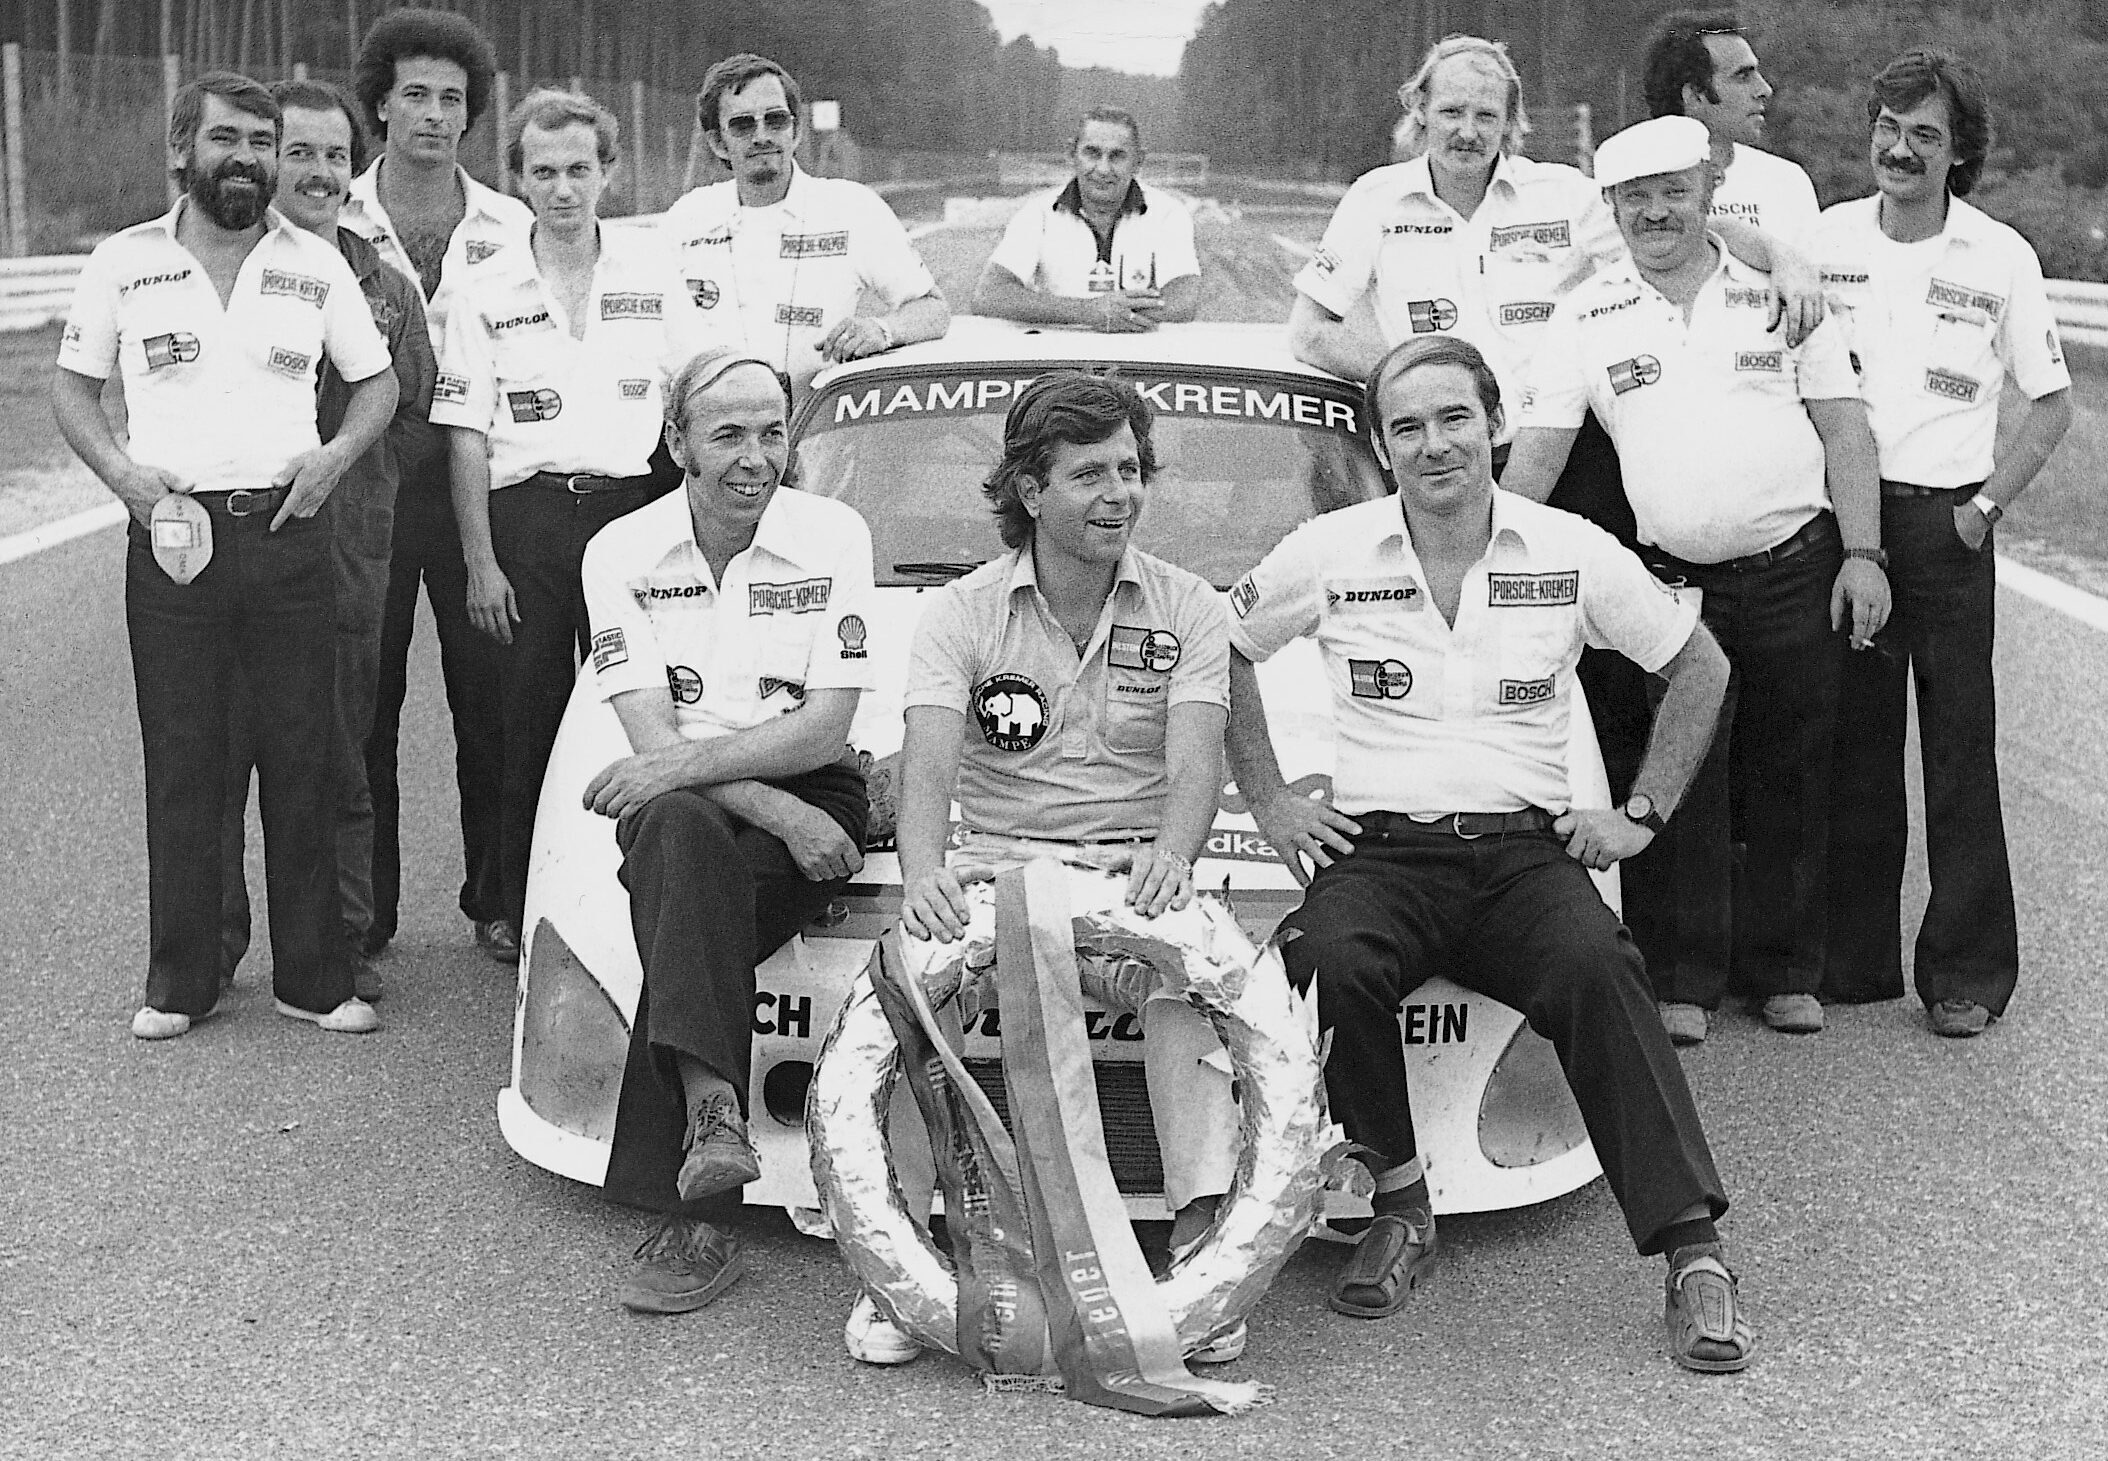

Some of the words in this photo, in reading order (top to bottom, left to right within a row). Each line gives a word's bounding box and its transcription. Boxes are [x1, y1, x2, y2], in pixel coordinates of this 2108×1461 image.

[1707, 204, 1760, 215] RSCHE
[1394, 225, 1452, 234] DUNLOP
[133, 270, 192, 290] DUNLOP
[495, 312, 550, 330] DUNLOP
[779, 311, 821, 325] BOSCH
[1504, 307, 1551, 321] BOSCH
[1929, 377, 1975, 398] BOSCH
[834, 380, 1024, 422] MAMP
[1133, 381, 1357, 432] KREMER
[649, 586, 706, 599] DUNLOP
[1345, 589, 1416, 601] DUNLOP
[1493, 581, 1575, 601] PORSCHE-KREMER
[840, 650, 867, 659] Shell
[1117, 685, 1161, 694] DUNLOP
[1505, 684, 1551, 701] BOSCH
[995, 675, 1035, 688] KREMER
[1035, 688, 1049, 726] RACING
[985, 725, 1031, 750] MAMPE
[1207, 834, 1279, 857] dka
